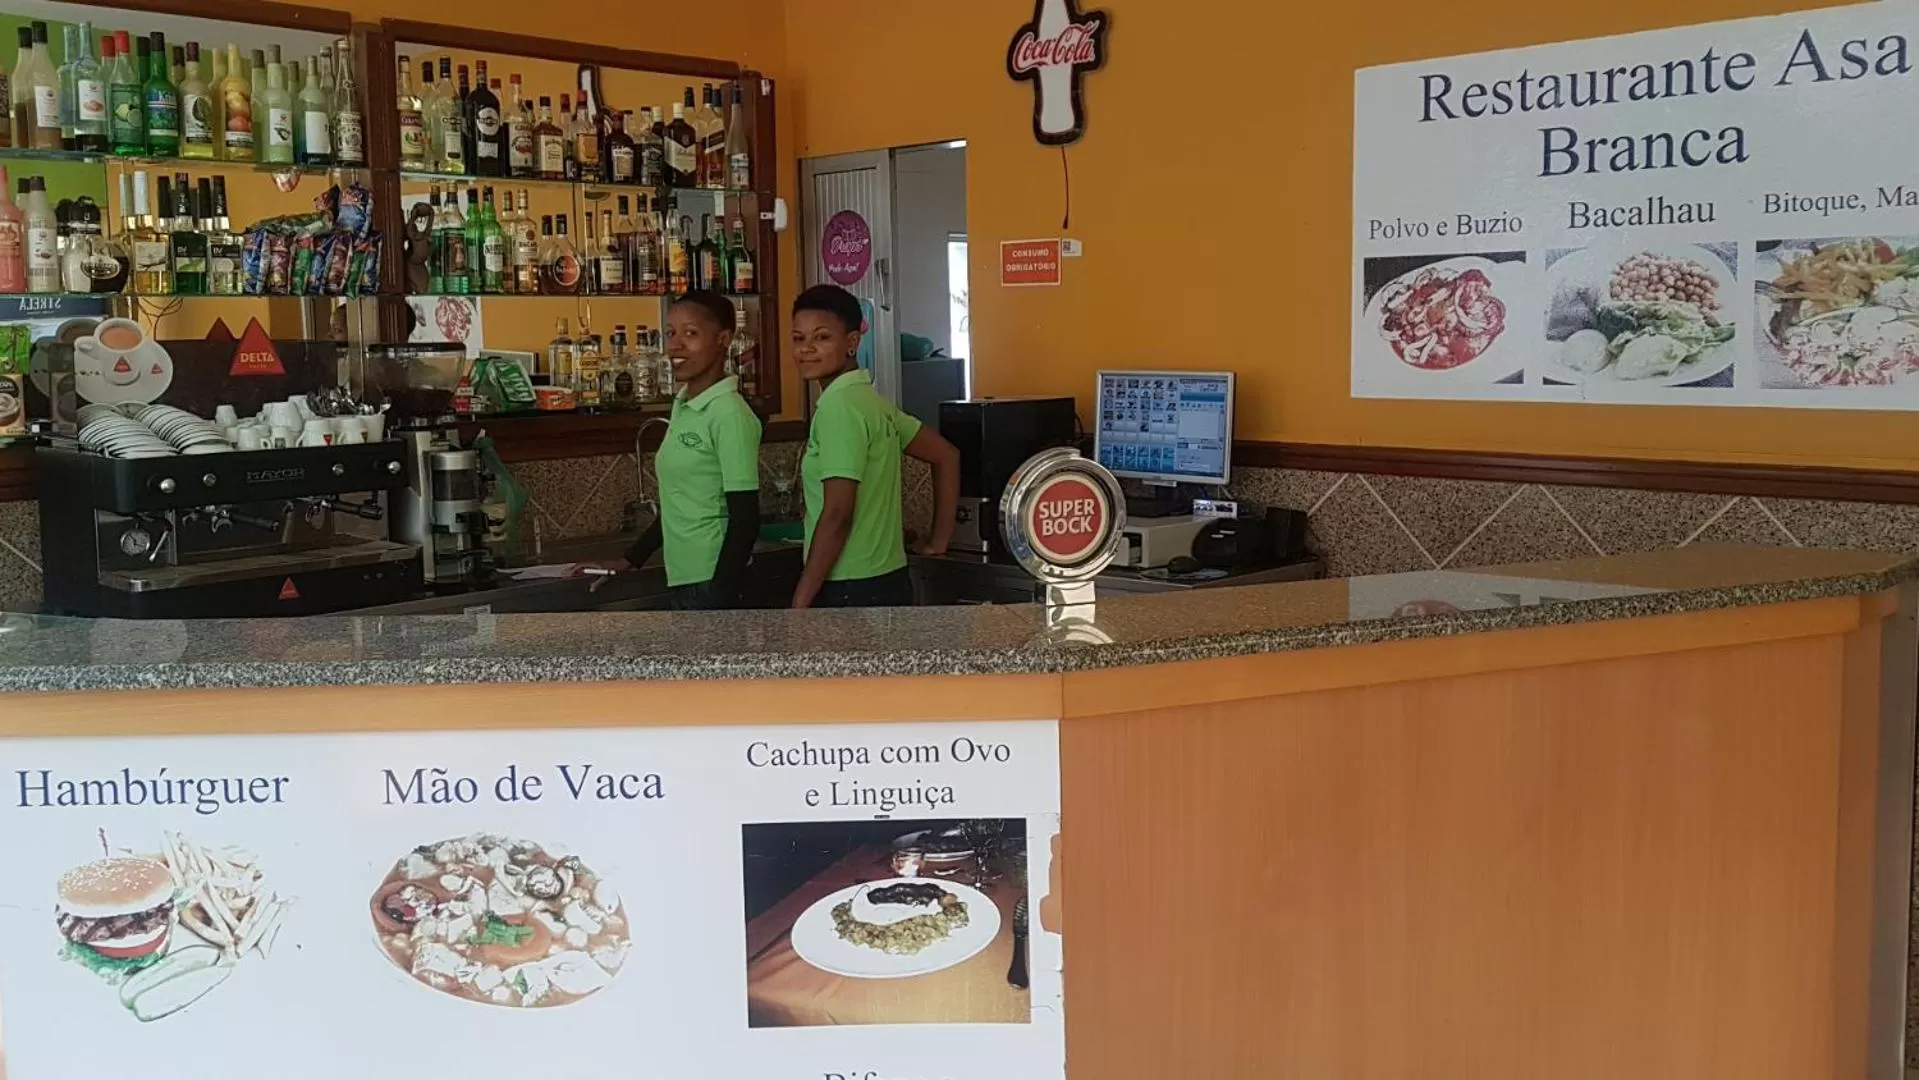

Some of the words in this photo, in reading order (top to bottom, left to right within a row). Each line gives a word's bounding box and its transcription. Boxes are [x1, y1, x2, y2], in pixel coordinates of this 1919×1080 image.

[1013, 20, 1100, 72] Coca-Cola
[1418, 45, 1756, 123] Restaurante
[1773, 28, 1913, 87] Asa
[1537, 126, 1751, 178] Branca
[1567, 196, 1717, 229] Bacalhau
[1763, 192, 1867, 217] Bitoque,
[1369, 217, 1430, 240] Polvo
[1436, 220, 1448, 237] e
[1455, 211, 1523, 236] Buzio
[1012, 248, 1050, 258] CONSUMO
[239, 351, 275, 363] DELTA
[1038, 498, 1095, 519] SUPER
[1042, 515, 1093, 536] BOCK
[746, 740, 871, 773] Cachupa
[880, 746, 940, 764] com
[950, 737, 1011, 763] Ovo
[15, 768, 290, 816] Hambúrguer
[381, 767, 479, 805] Mão
[494, 765, 543, 803] de
[555, 764, 666, 801] Vaca
[804, 788, 820, 808] e
[828, 779, 957, 812] Linguiça
